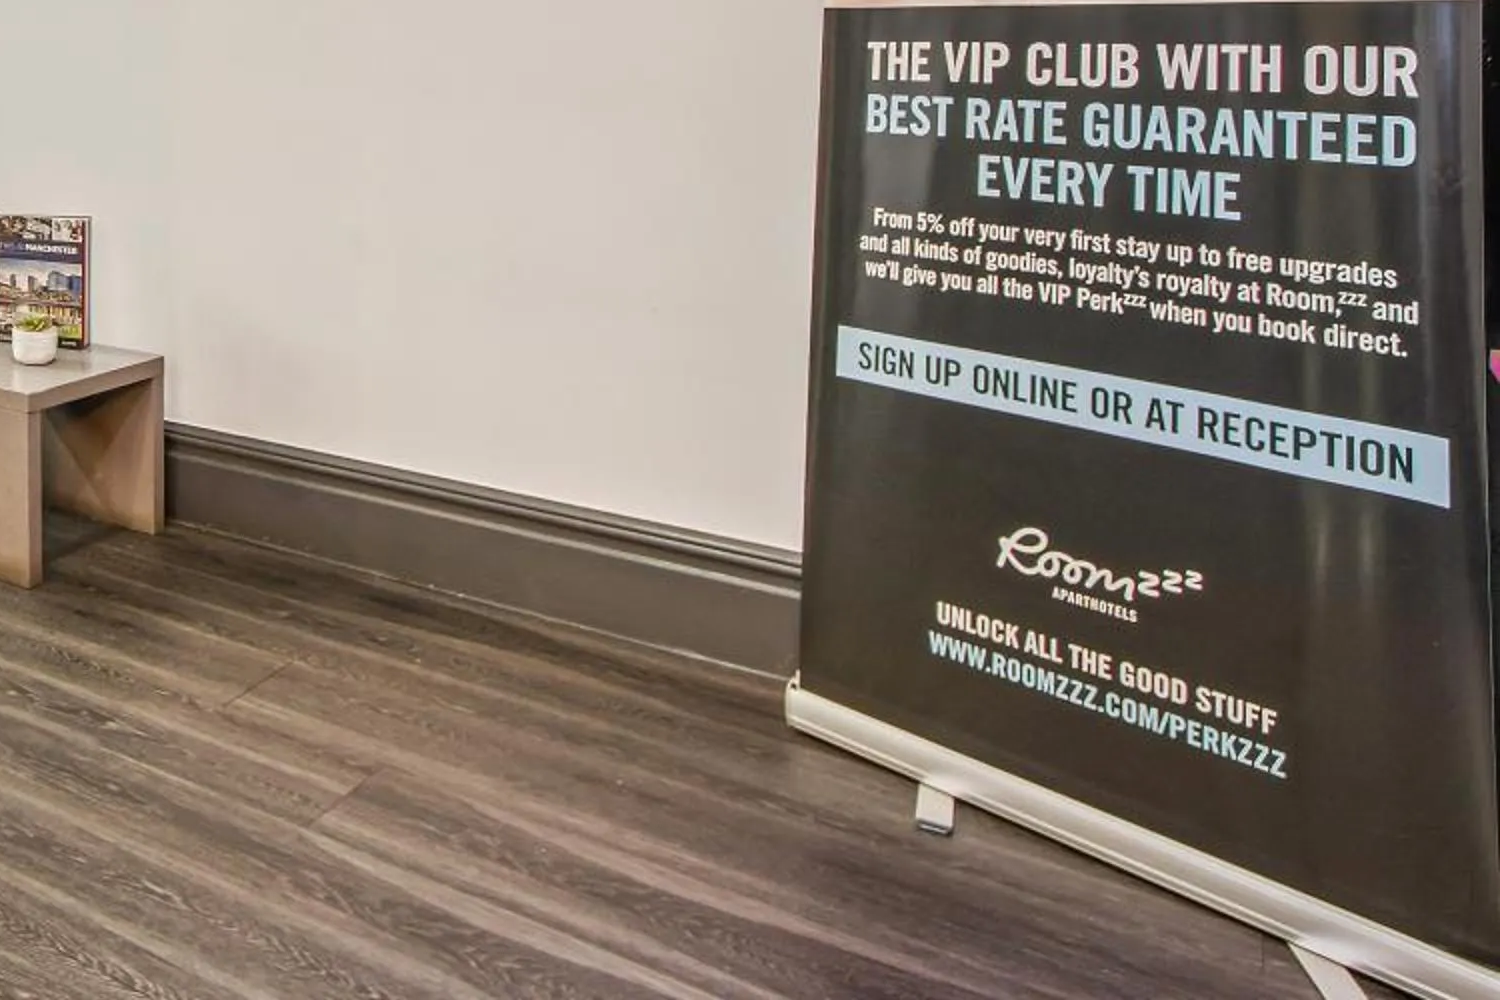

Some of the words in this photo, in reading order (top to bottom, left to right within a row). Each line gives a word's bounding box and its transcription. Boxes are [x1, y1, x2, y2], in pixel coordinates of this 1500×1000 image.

[867, 41, 931, 81] THE
[944, 41, 1010, 84] VIP
[1026, 42, 1139, 88] CLUB
[1156, 43, 1282, 93] WITH
[1304, 45, 1419, 98] OUR
[866, 93, 954, 137] BEST
[965, 97, 1067, 145] RATE
[1083, 102, 1417, 167] GUARANTEED
[977, 154, 1115, 207] EVERY
[1127, 164, 1241, 220] TIME
[860, 234, 888, 251] and
[891, 236, 910, 253] all
[913, 237, 959, 262] kinds
[963, 247, 981, 265] of
[985, 251, 1063, 279] goodies,
[1069, 258, 1150, 290] loyalty's
[1156, 272, 1232, 303] royalty
[1237, 280, 1260, 304] at
[1371, 301, 1419, 325] and
[873, 207, 912, 230] From
[916, 211, 945, 234] 5%
[950, 217, 974, 237] off
[978, 222, 1019, 243] your
[1024, 227, 1066, 251] very
[1071, 230, 1110, 254] first
[1116, 235, 1160, 262] stay
[1166, 244, 1192, 267] up
[1200, 244, 1221, 267] to
[1226, 246, 1273, 273] free
[1279, 256, 1398, 289] upgrades
[865, 260, 899, 280] we'll
[903, 264, 937, 287] give
[941, 271, 972, 292] you
[976, 275, 998, 295] all
[1003, 279, 1032, 300] the
[1037, 281, 1072, 305] VIP
[1150, 300, 1207, 327] when
[1212, 311, 1252, 333] you
[1258, 313, 1317, 344] book
[1323, 324, 1409, 358] direct.
[858, 342, 914, 379] SIGN
[925, 355, 961, 387] UP
[973, 363, 1078, 413] ONLINE
[1090, 387, 1132, 424] OR
[1145, 397, 1184, 434] AT
[1198, 407, 1414, 484] RECEPTION
[1052, 586, 1138, 623] APARTHOTELS
[928, 630, 1288, 779] WWW.ROOMZZZ.COM/PERKZZZ
[936, 600, 1019, 650] UNLOCK
[1023, 630, 1063, 664] ALL
[1068, 643, 1113, 680] THE
[1119, 661, 1188, 705] GOOD
[1195, 686, 1277, 735] STUFF
